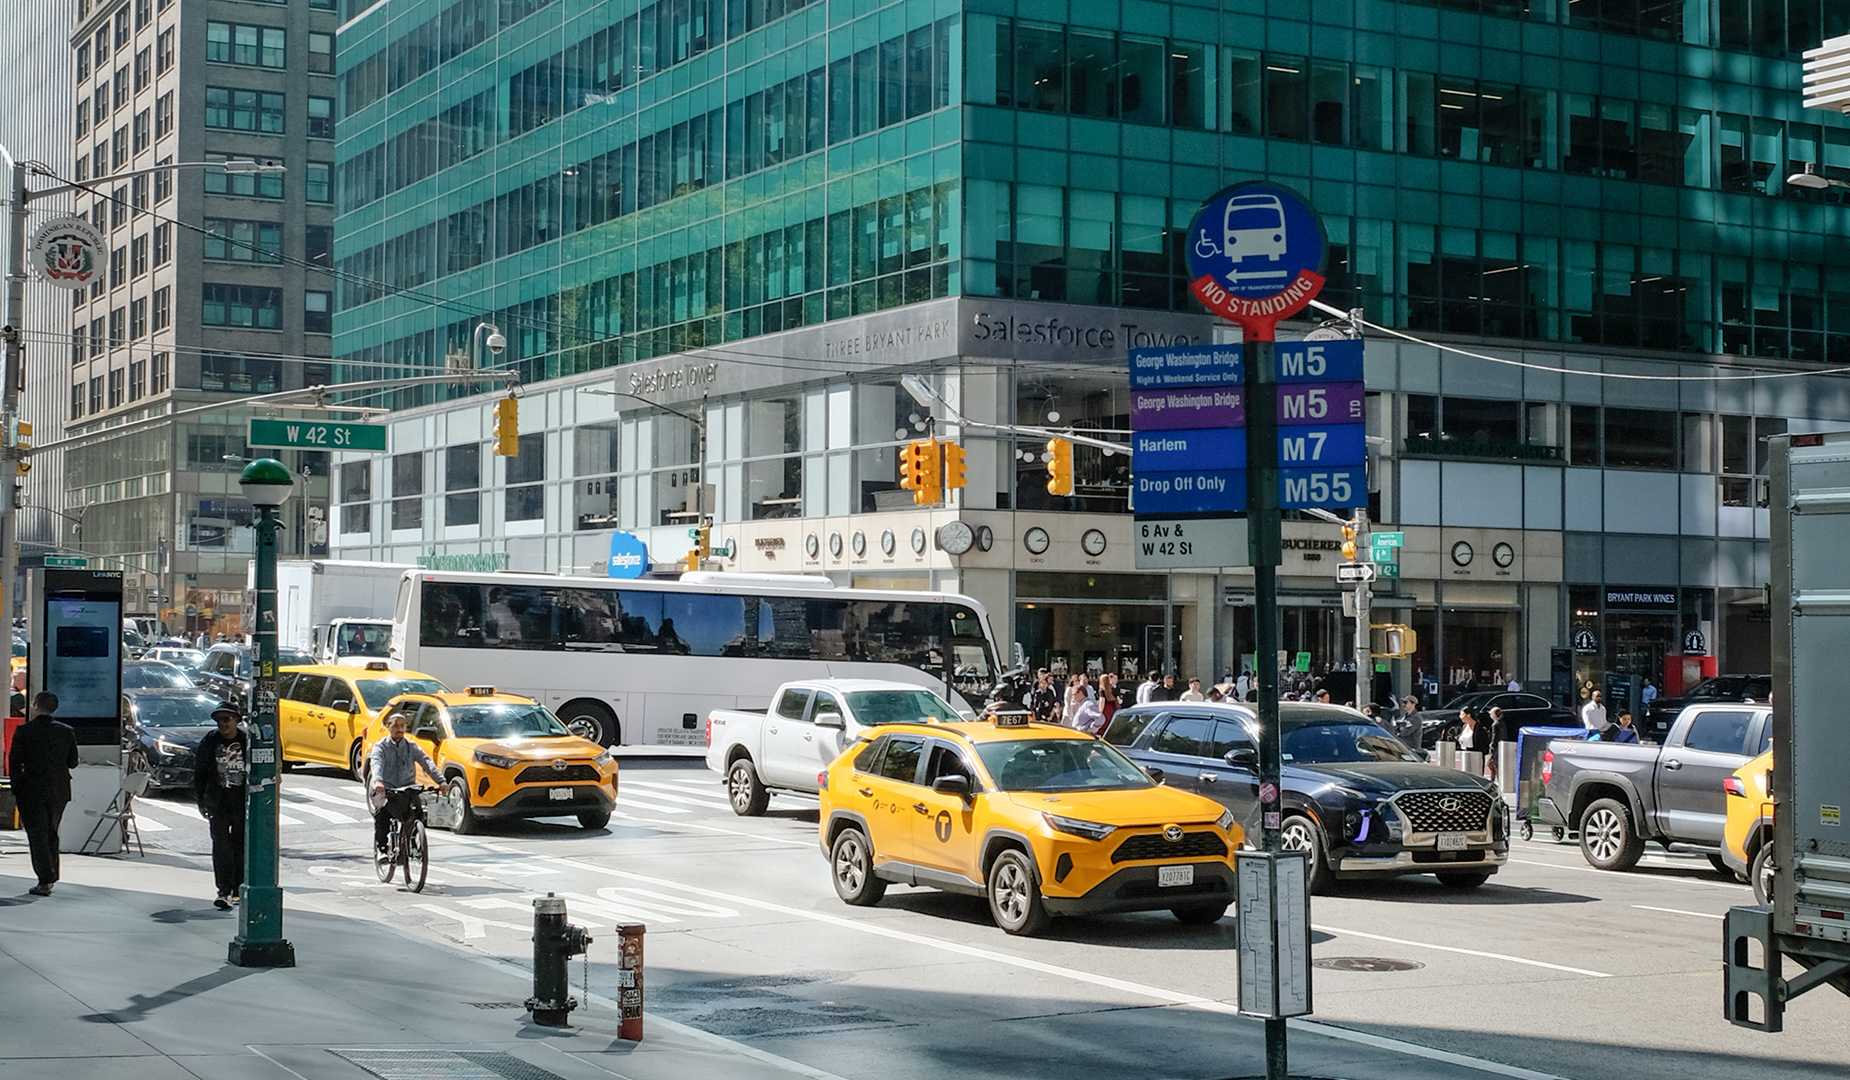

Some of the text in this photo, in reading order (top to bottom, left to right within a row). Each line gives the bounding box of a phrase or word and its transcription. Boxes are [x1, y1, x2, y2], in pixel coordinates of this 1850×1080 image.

[1201, 277, 1313, 316] NO STANDING
[825, 319, 950, 360] THREE BRYANT PARK
[974, 313, 1115, 349] Salesforce
[1136, 351, 1239, 370] George Washington Bridge
[1281, 347, 1326, 376] M5
[629, 360, 719, 395] Salesforce Tower
[1136, 375, 1154, 386] Night
[1163, 374, 1193, 383] Weekend
[1195, 373, 1220, 382] Service
[1222, 372, 1238, 383] Only
[1137, 392, 1240, 411] George Washington Bridge
[1283, 389, 1328, 419] M5
[1349, 400, 1361, 417] LTD
[287, 425, 351, 445] W 42 St
[1140, 438, 1187, 452] Harlem
[1283, 432, 1327, 461] M7
[1140, 476, 1226, 493] Drop Off Only
[1285, 473, 1352, 503] M55
[1141, 524, 1184, 537] 6 Av &
[1142, 542, 1193, 556] W 42 St
[1281, 540, 1342, 550] BUCHERER
[1607, 592, 1676, 604] BRYANT PARK WINES
[1001, 715, 1022, 725] 7E67
